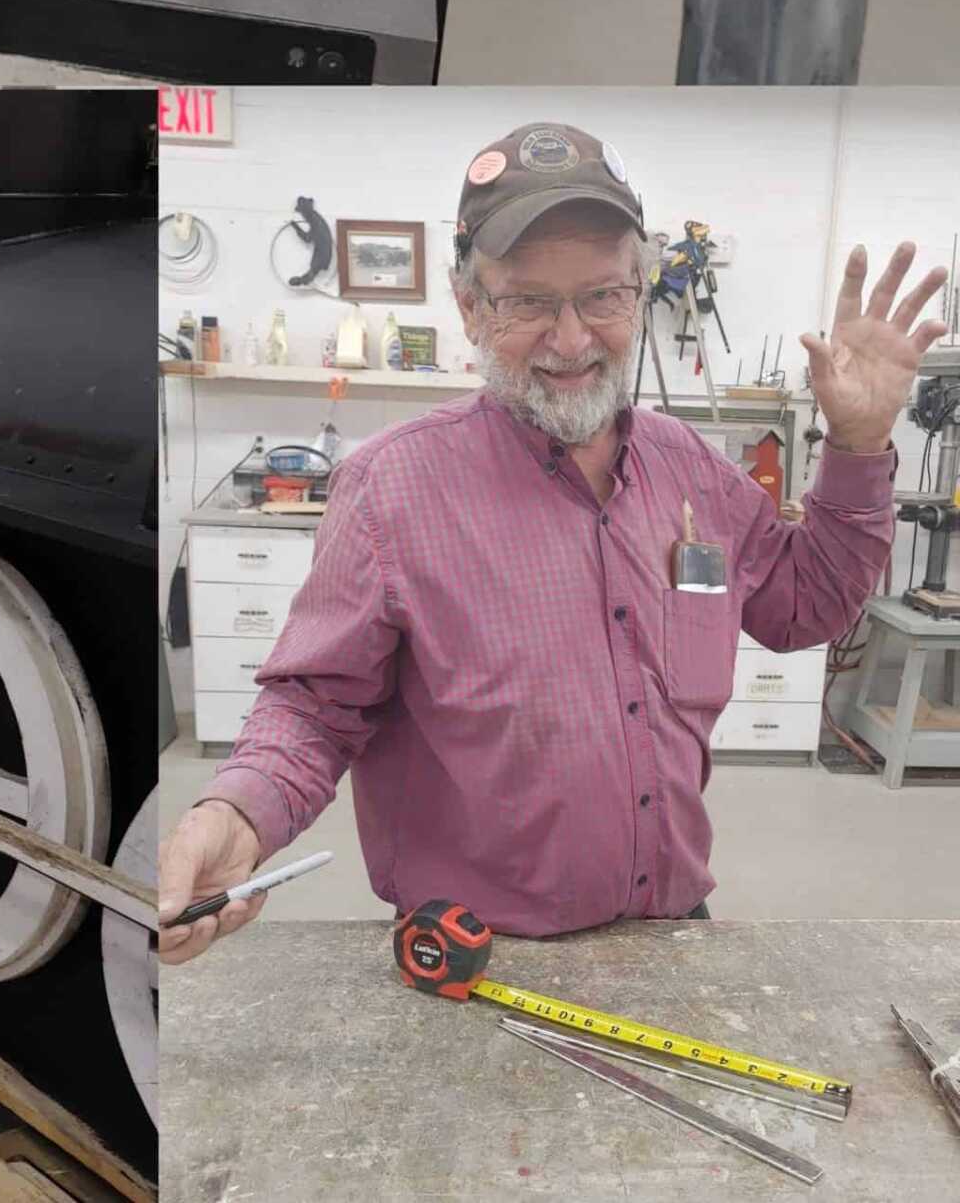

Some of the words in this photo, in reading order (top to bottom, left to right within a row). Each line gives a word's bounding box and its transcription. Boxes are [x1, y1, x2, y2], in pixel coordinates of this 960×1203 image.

[159, 86, 217, 135] EXIT
[558, 1010, 577, 1022] 10
[583, 1018, 595, 1028] 9
[609, 1025, 621, 1035] 8
[662, 1040, 674, 1050] 6
